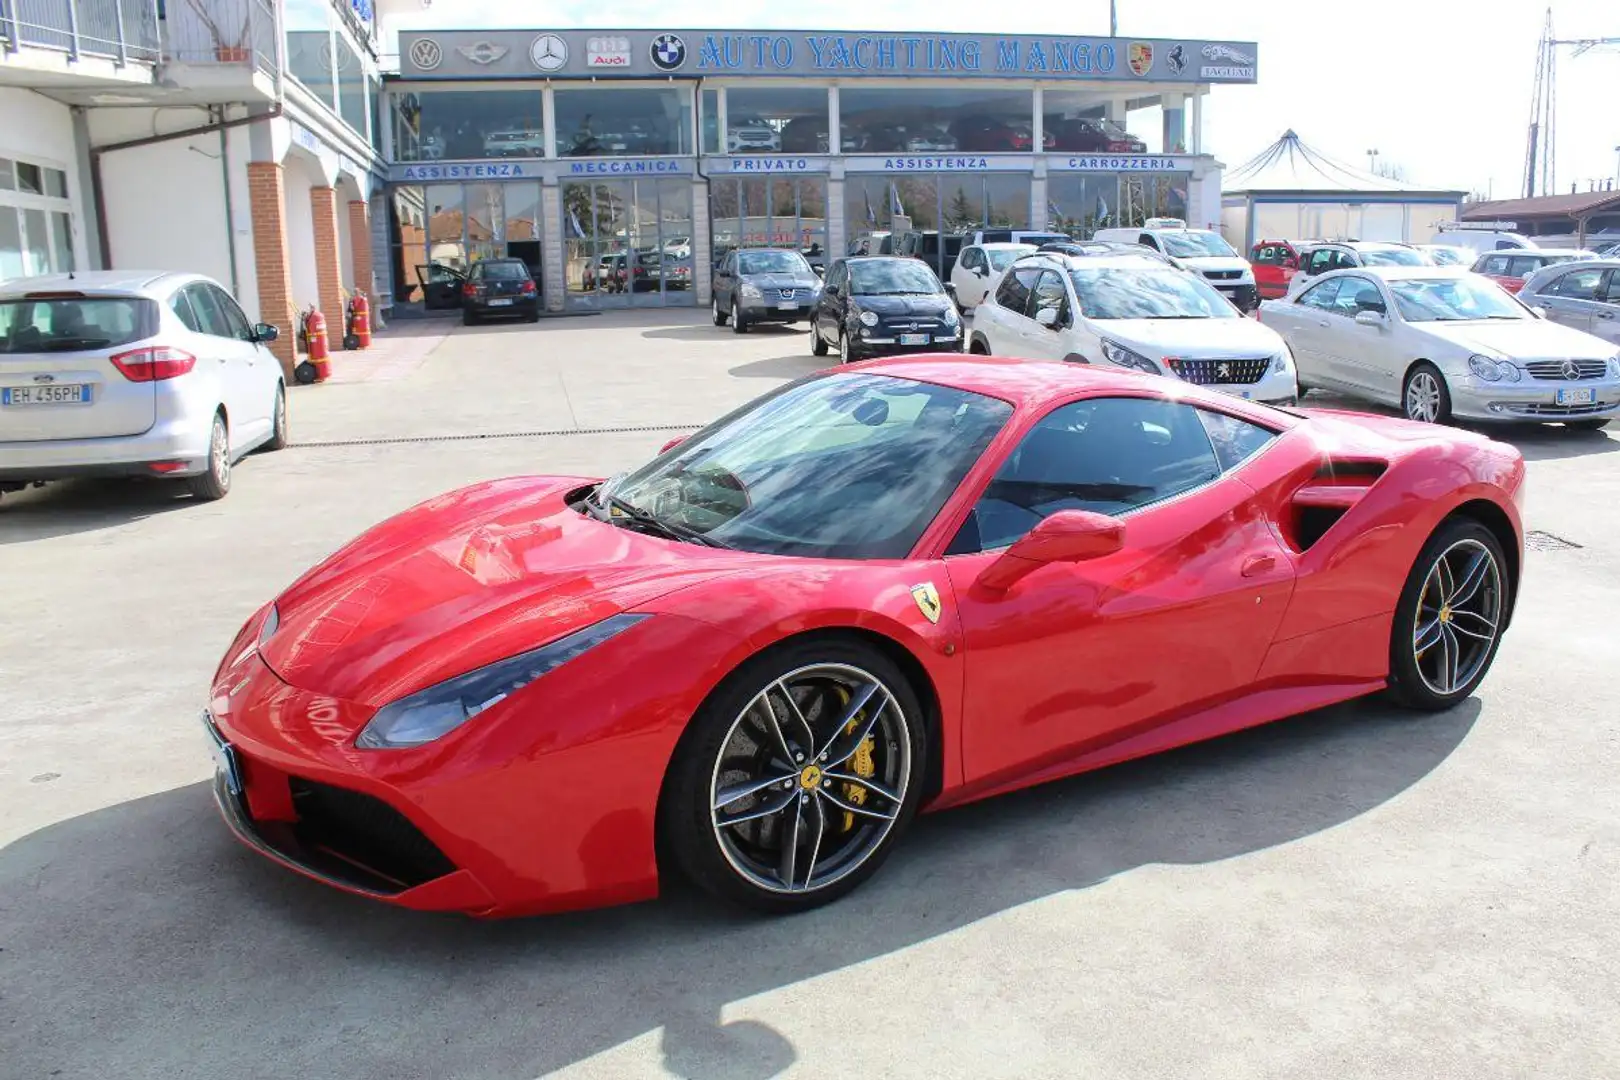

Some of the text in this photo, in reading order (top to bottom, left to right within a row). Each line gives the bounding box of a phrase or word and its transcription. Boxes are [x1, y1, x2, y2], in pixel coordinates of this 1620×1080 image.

[697, 34, 1116, 73] AUTO YACHTING MANGO
[594, 56, 626, 64] Audi
[1203, 67, 1253, 77] JAGUAR
[571, 160, 680, 173] MECCANICA
[733, 159, 806, 170] PRIVATO
[884, 158, 988, 169] ASSISTENZA
[1069, 158, 1176, 169] CARROZZERIA
[404, 163, 524, 178] ASSISTENZA
